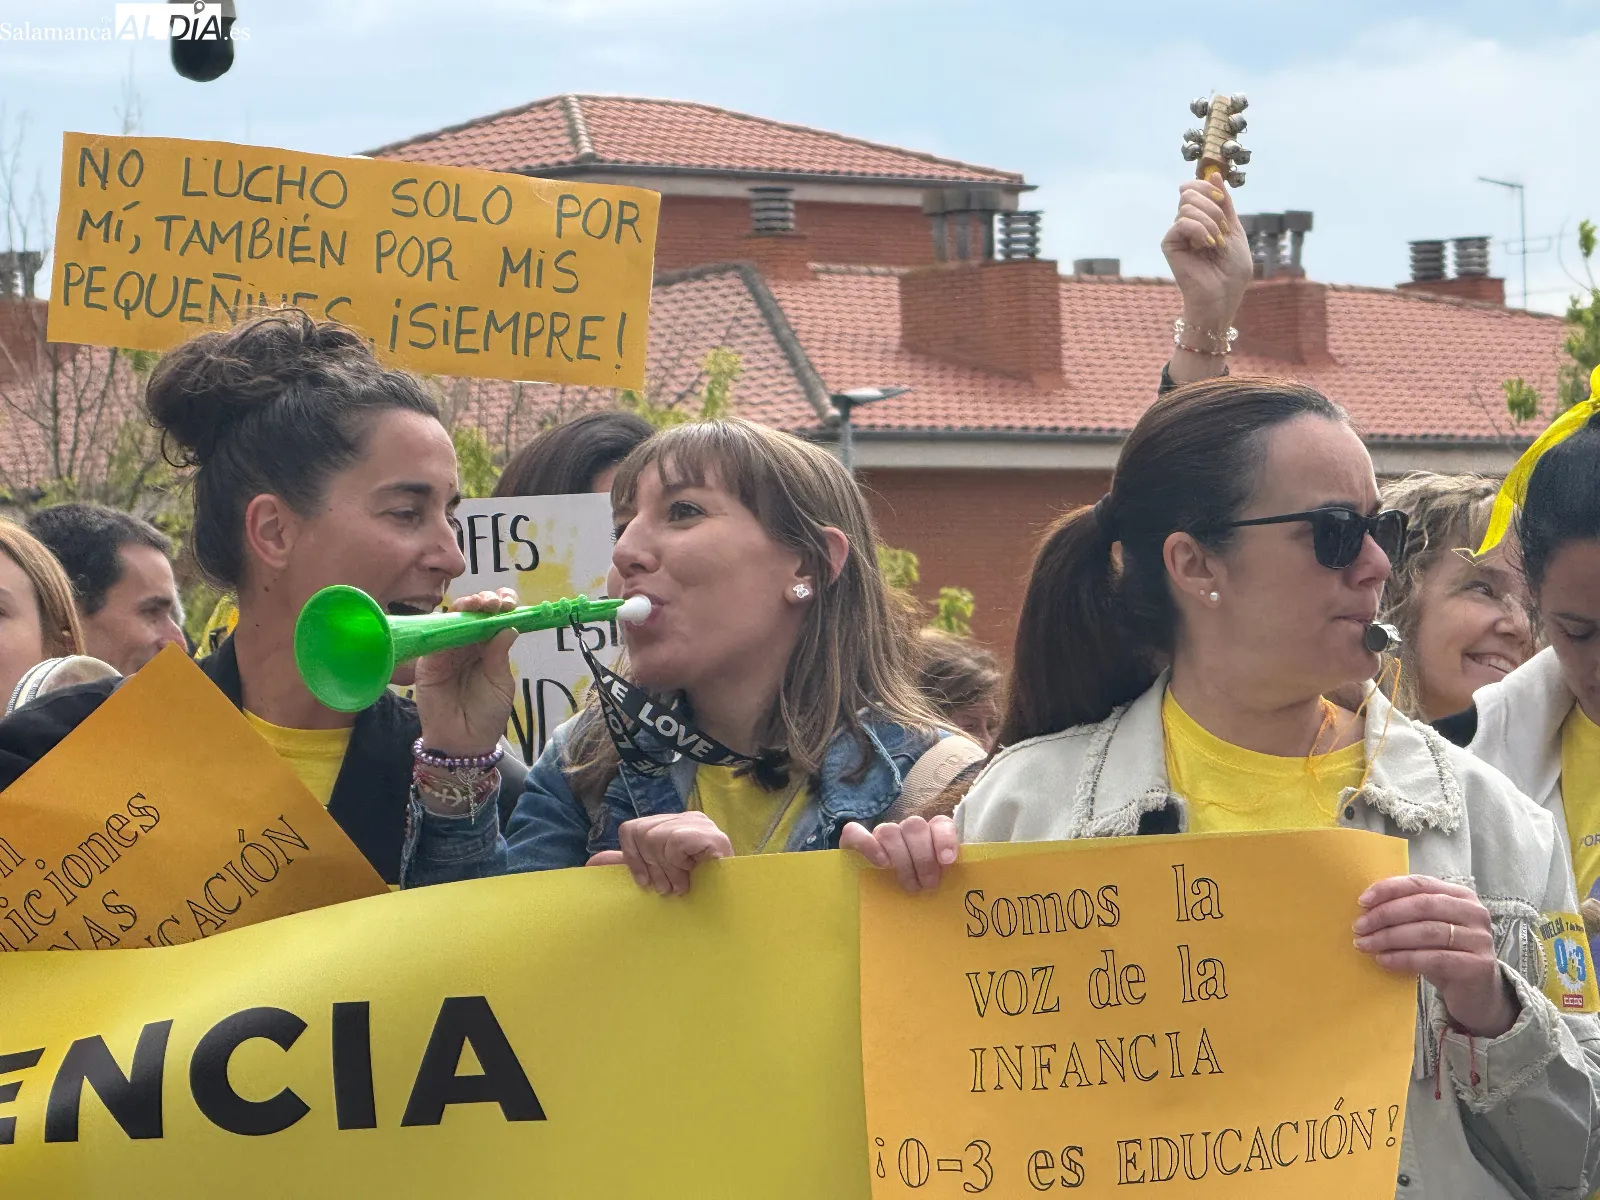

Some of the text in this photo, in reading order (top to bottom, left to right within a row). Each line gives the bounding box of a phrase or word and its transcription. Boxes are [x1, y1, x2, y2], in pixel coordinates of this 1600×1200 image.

[78, 147, 642, 244] NO LUCHO SOLO POR
[375, 229, 459, 282] POR
[638, 701, 714, 758] LOVE
[964, 864, 1224, 938] Somos la
[1087, 949, 1147, 1010] de
[1177, 944, 1229, 1004] la
[969, 1027, 1224, 1093] INFANCIA
[1026, 1144, 1086, 1190] es
